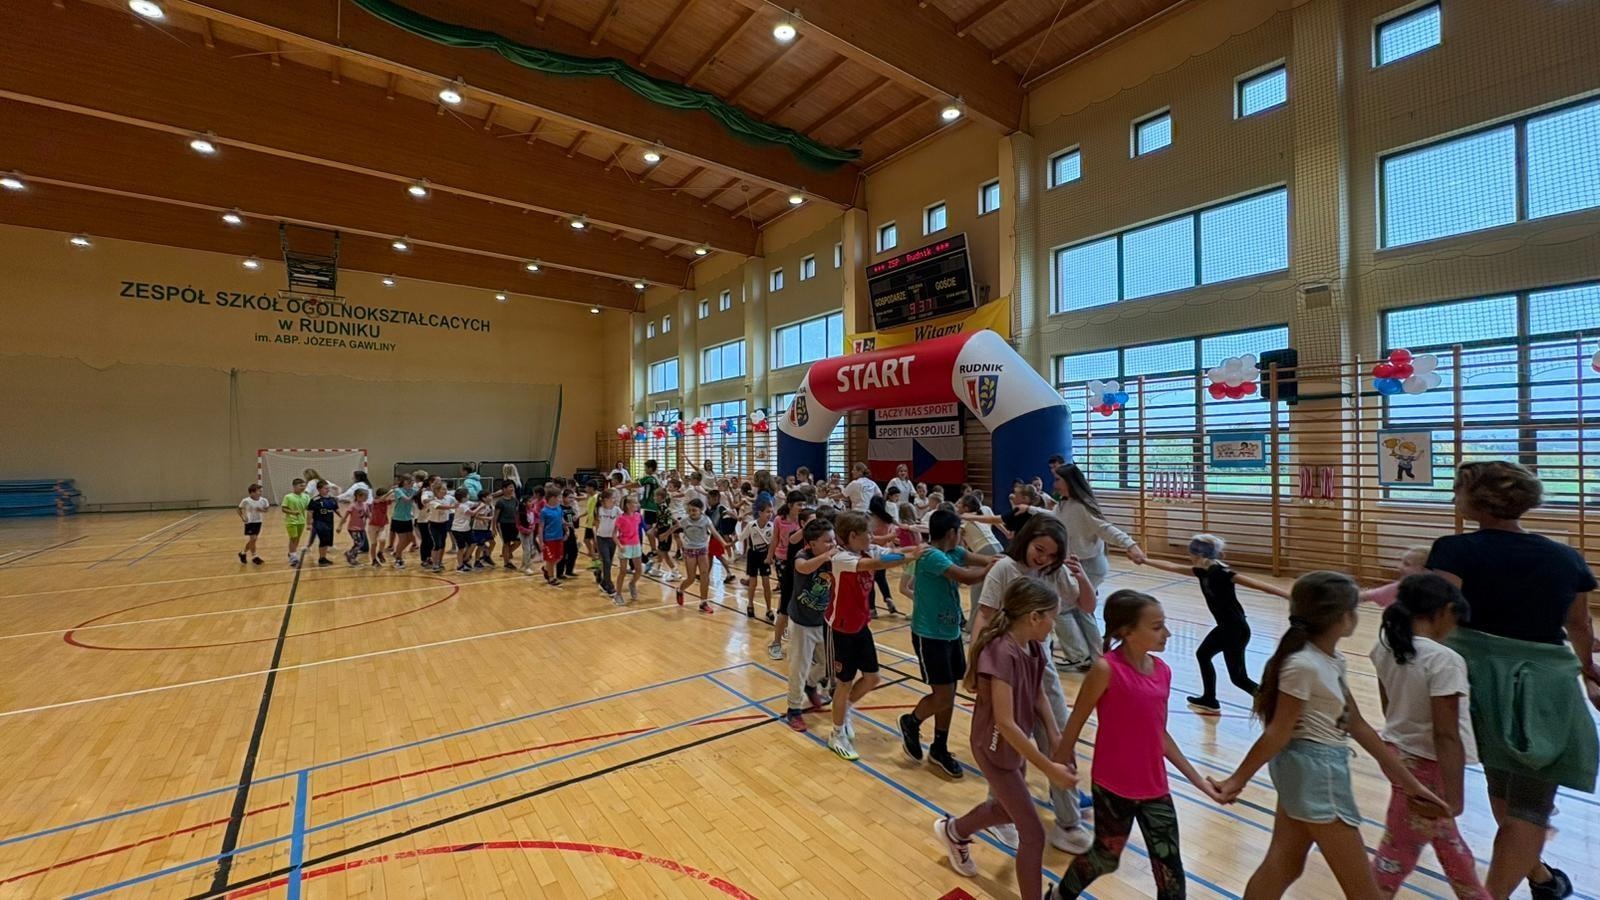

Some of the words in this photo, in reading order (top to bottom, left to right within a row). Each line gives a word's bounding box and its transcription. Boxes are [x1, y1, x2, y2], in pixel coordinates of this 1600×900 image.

[935, 276, 957, 290] GOŚCIE
[120, 281, 211, 305] ZESPÓŁ
[216, 291, 283, 312] SZKÓŁ
[278, 319, 293, 330] w
[300, 318, 380, 338] RUDNIKU
[914, 322, 965, 342] Witamy
[254, 332, 272, 343] im.
[274, 334, 300, 345] ABP.
[304, 335, 348, 348] JÓZEFA
[349, 340, 396, 352] GAWLINY
[836, 356, 916, 393] START
[959, 364, 1004, 375] RUDNIK
[878, 408, 904, 420] ŁĄCZY
[905, 407, 921, 416] NAS
[924, 403, 953, 415] SPORT
[879, 427, 903, 437] SPORT
[921, 424, 955, 436] SPOJUJE
